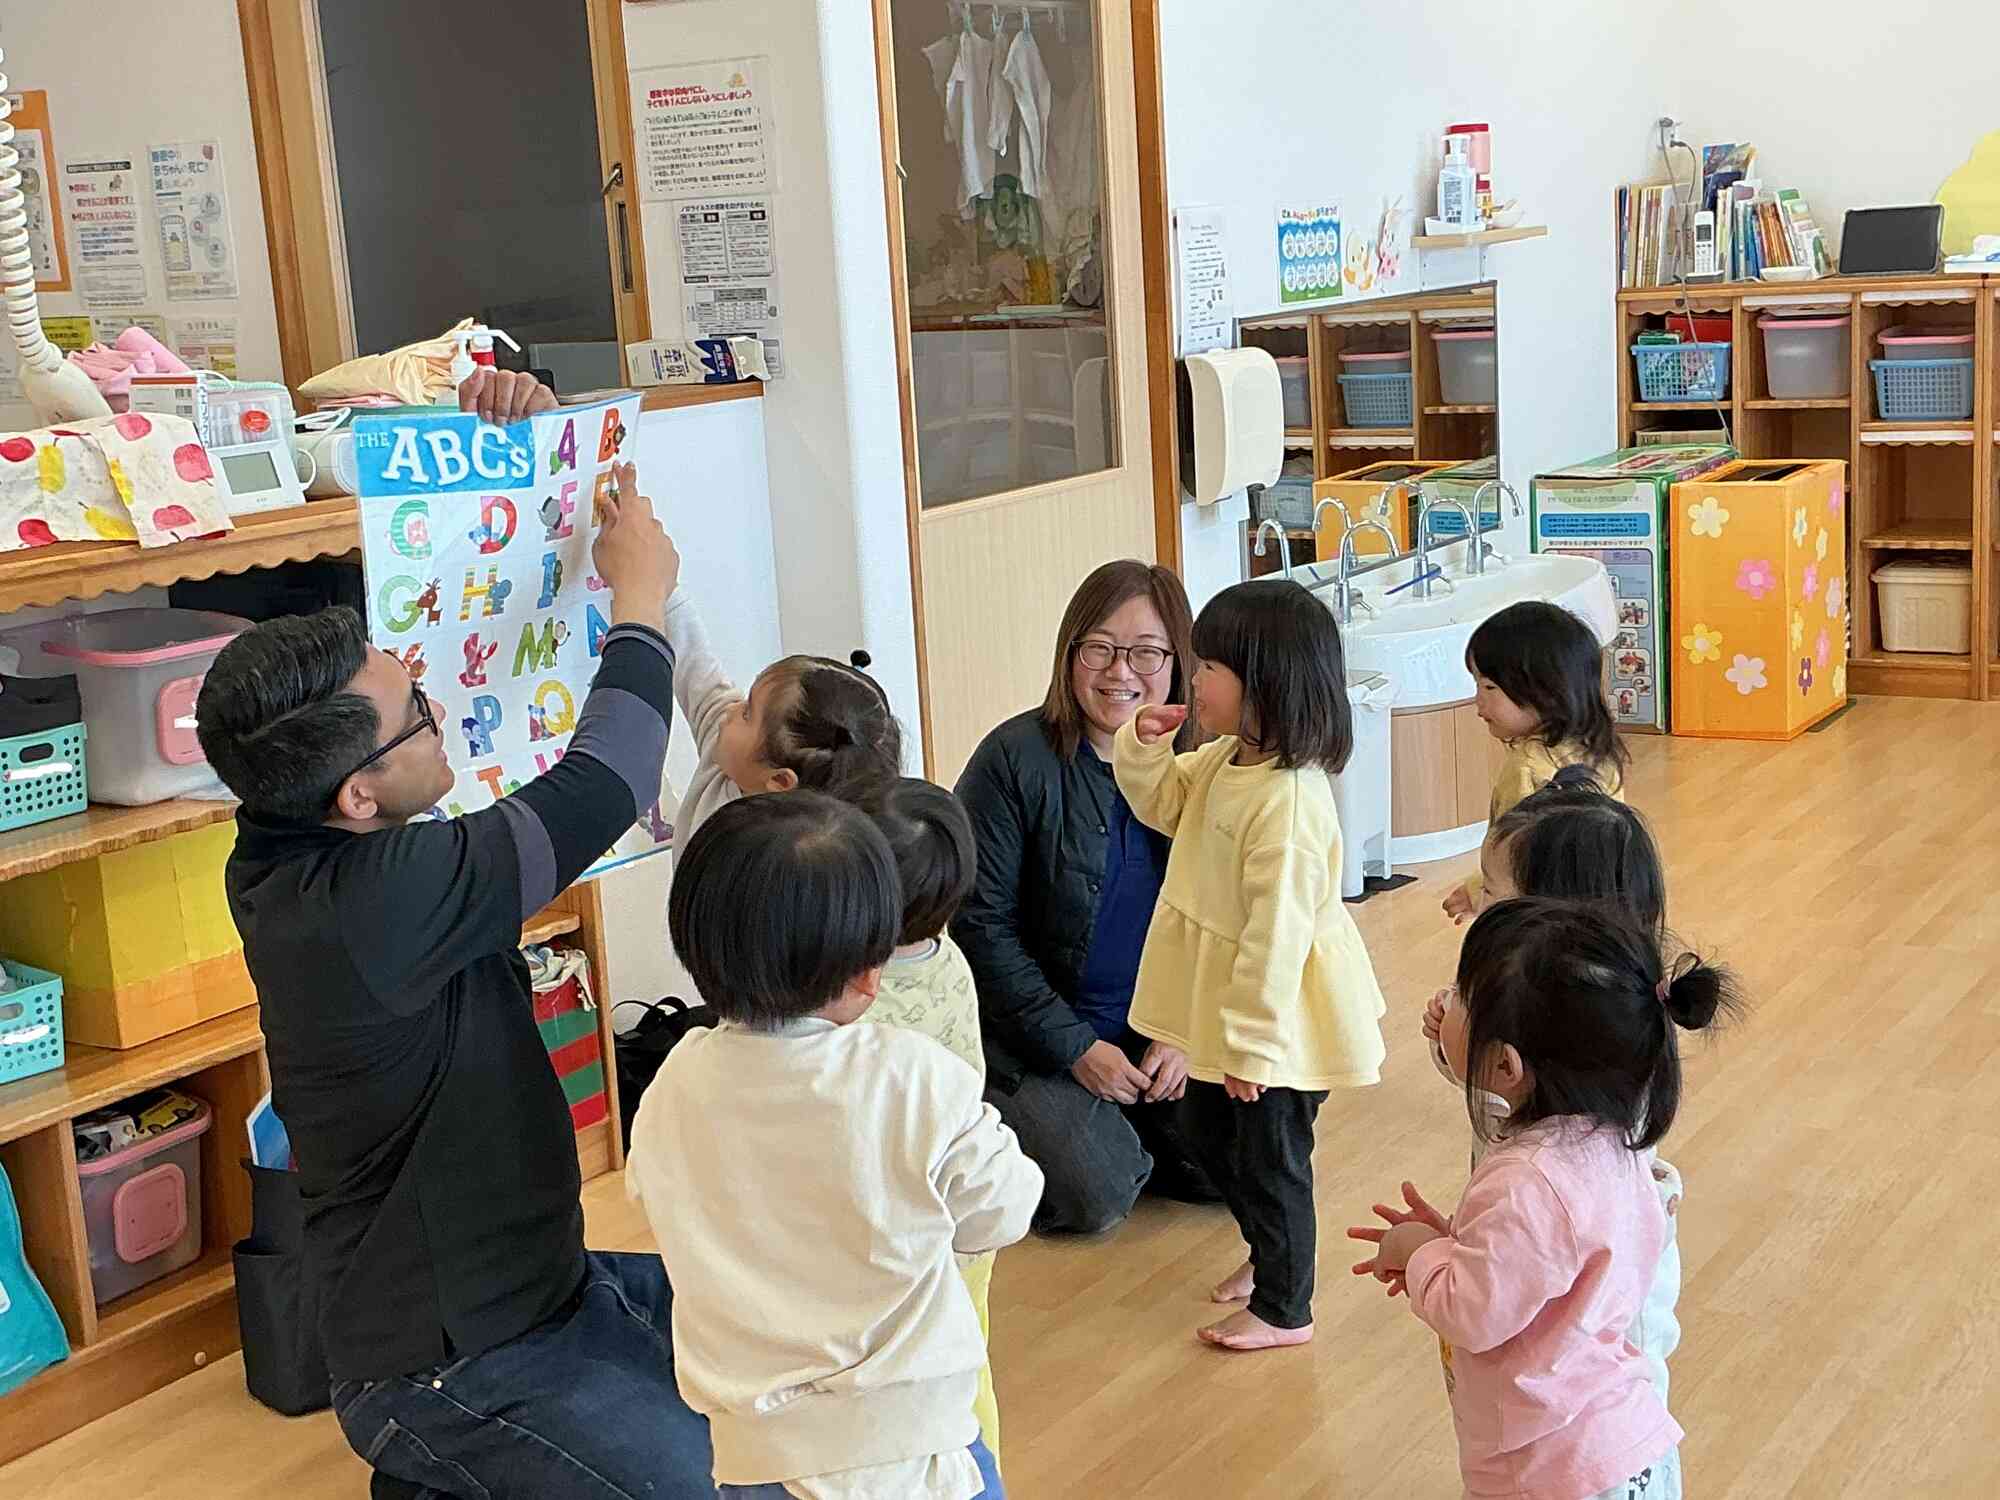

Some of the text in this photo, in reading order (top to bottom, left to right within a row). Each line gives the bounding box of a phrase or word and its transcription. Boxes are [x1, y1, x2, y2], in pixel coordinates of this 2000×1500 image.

[355, 424, 531, 486] THE ABCs
[553, 407, 624, 473] A B
[390, 499, 433, 560] C
[480, 495, 518, 555] D
[377, 574, 424, 633] G
[459, 564, 504, 621] H
[512, 617, 555, 678] M
[470, 680, 577, 756] P Q
[476, 765, 504, 799] T
